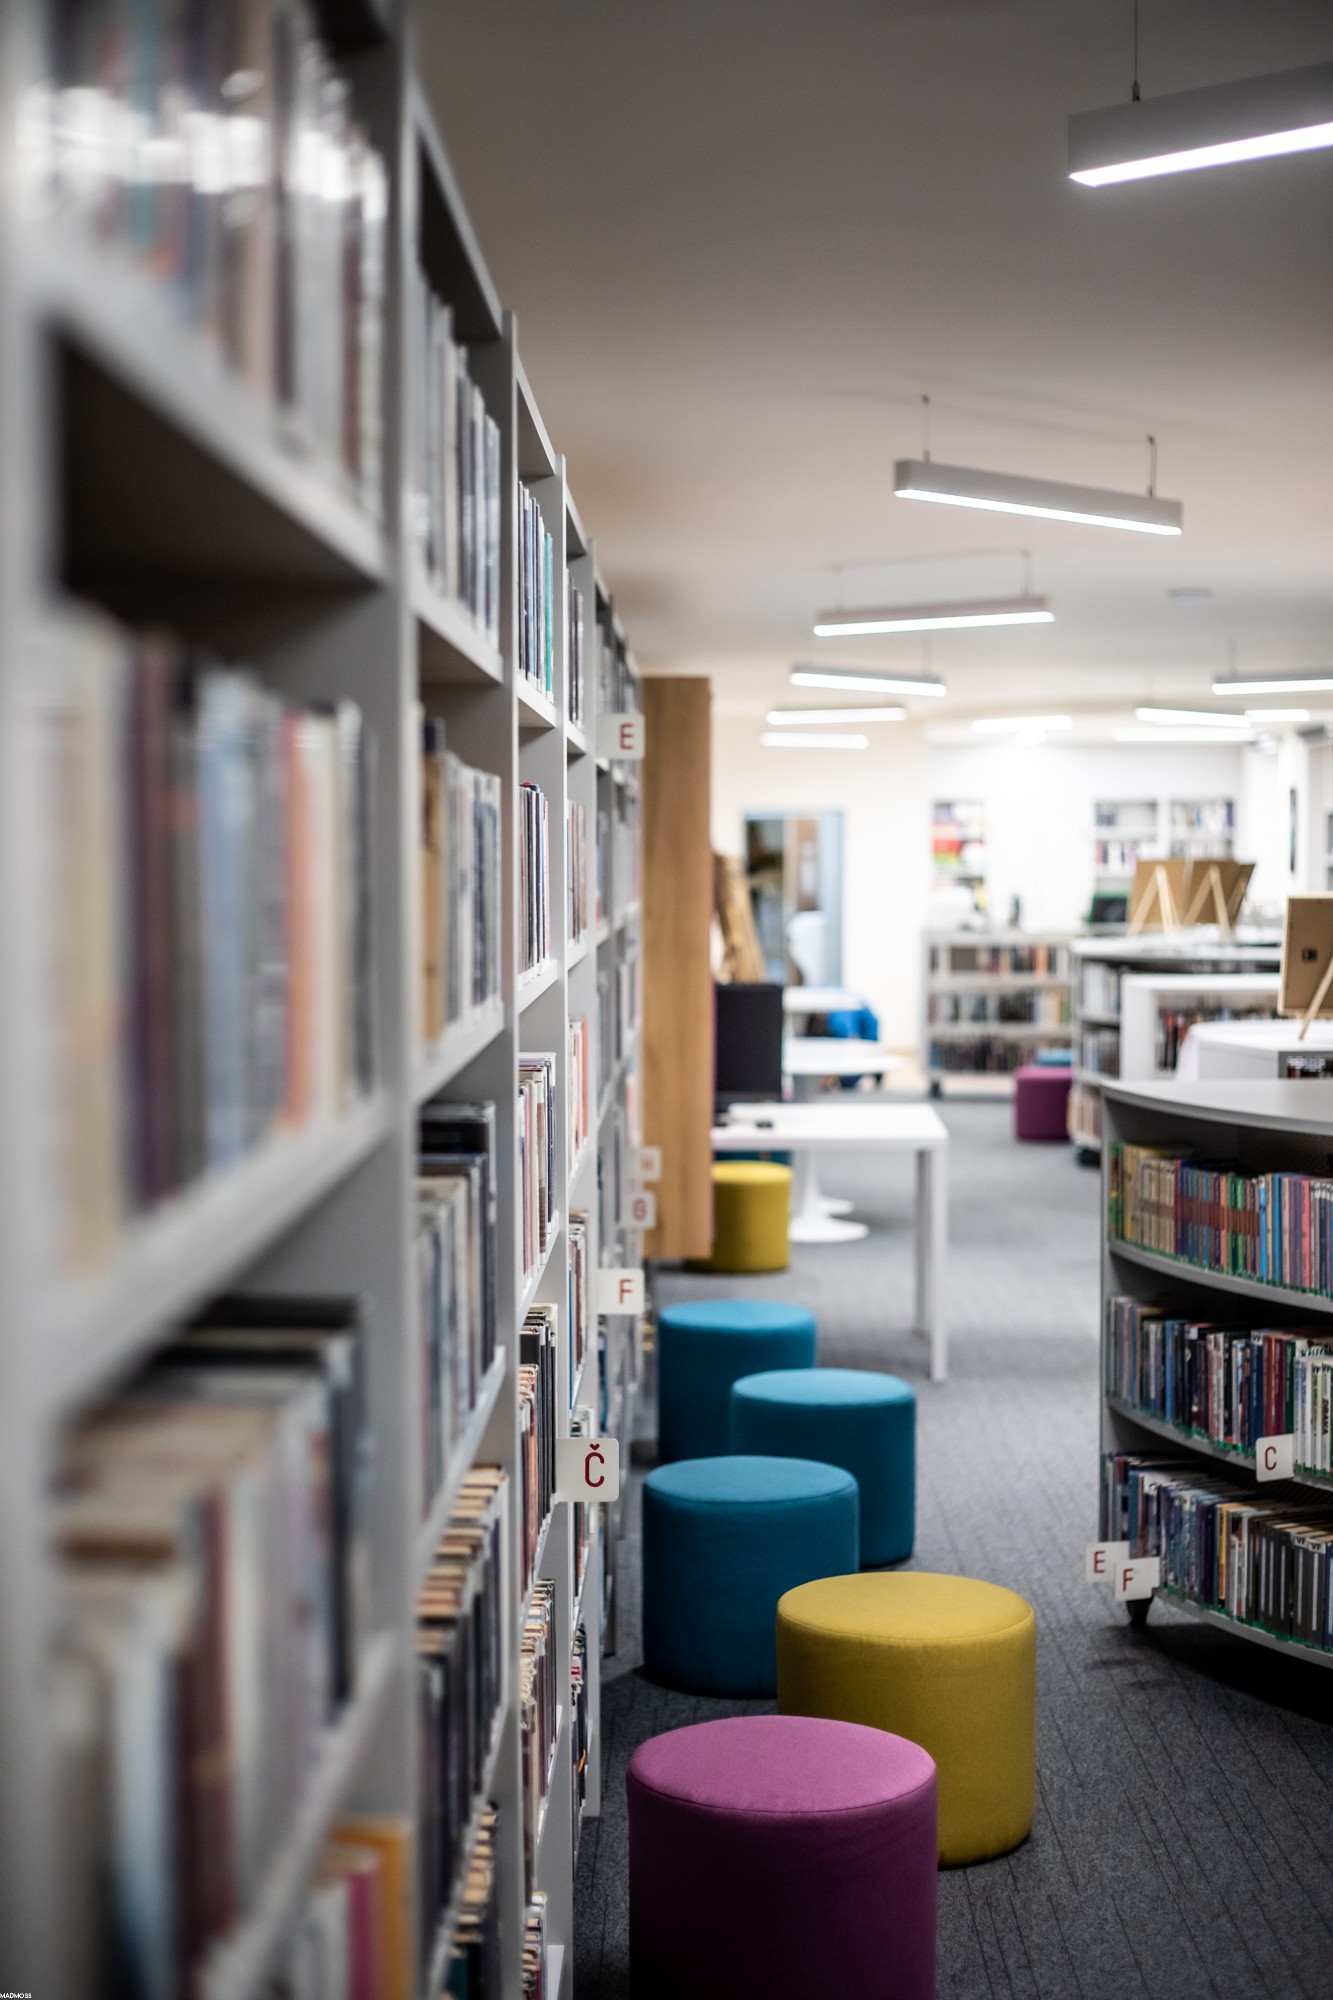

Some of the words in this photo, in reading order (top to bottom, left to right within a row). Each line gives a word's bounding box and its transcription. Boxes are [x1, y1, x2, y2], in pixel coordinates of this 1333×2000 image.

[619, 723, 634, 750] E
[618, 1278, 634, 1305] F
[584, 1443, 605, 1488] Č
[1264, 1446, 1277, 1471] C
[1094, 1550, 1106, 1574] E
[1122, 1567, 1135, 1593] F
